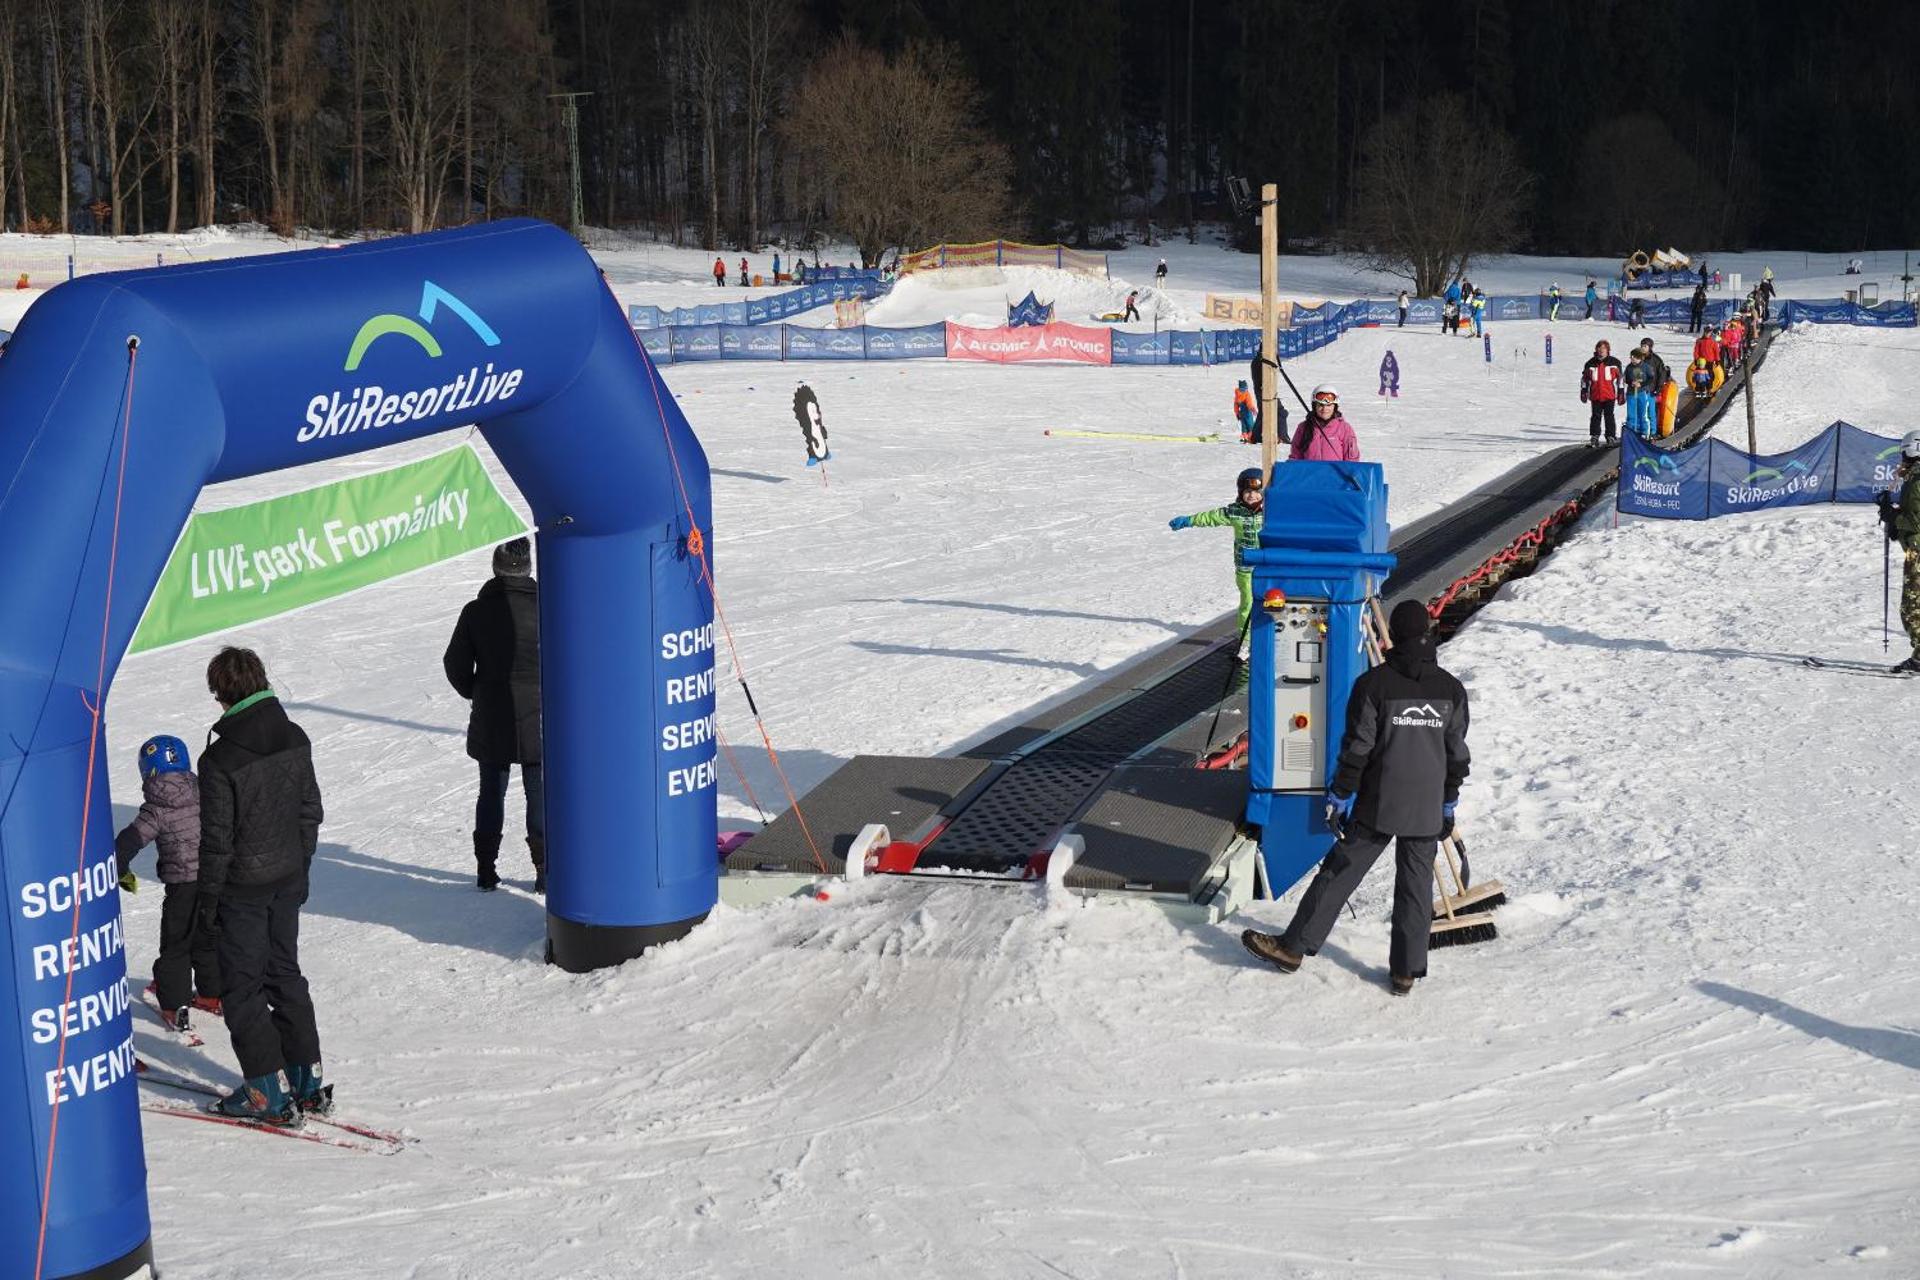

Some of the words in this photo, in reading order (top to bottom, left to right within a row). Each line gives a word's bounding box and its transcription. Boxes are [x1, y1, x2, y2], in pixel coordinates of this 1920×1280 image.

[969, 340, 1031, 353] ATOMIC
[1052, 336, 1105, 354] ATOMIC
[296, 363, 523, 443] SkiResortLive
[661, 624, 714, 660] SCHO
[666, 667, 715, 705] RENT
[662, 712, 715, 751] SERVI
[1392, 716, 1443, 728] SkiResortLiv
[668, 755, 717, 797] EVENT
[31, 975, 129, 1044] SERVIC
